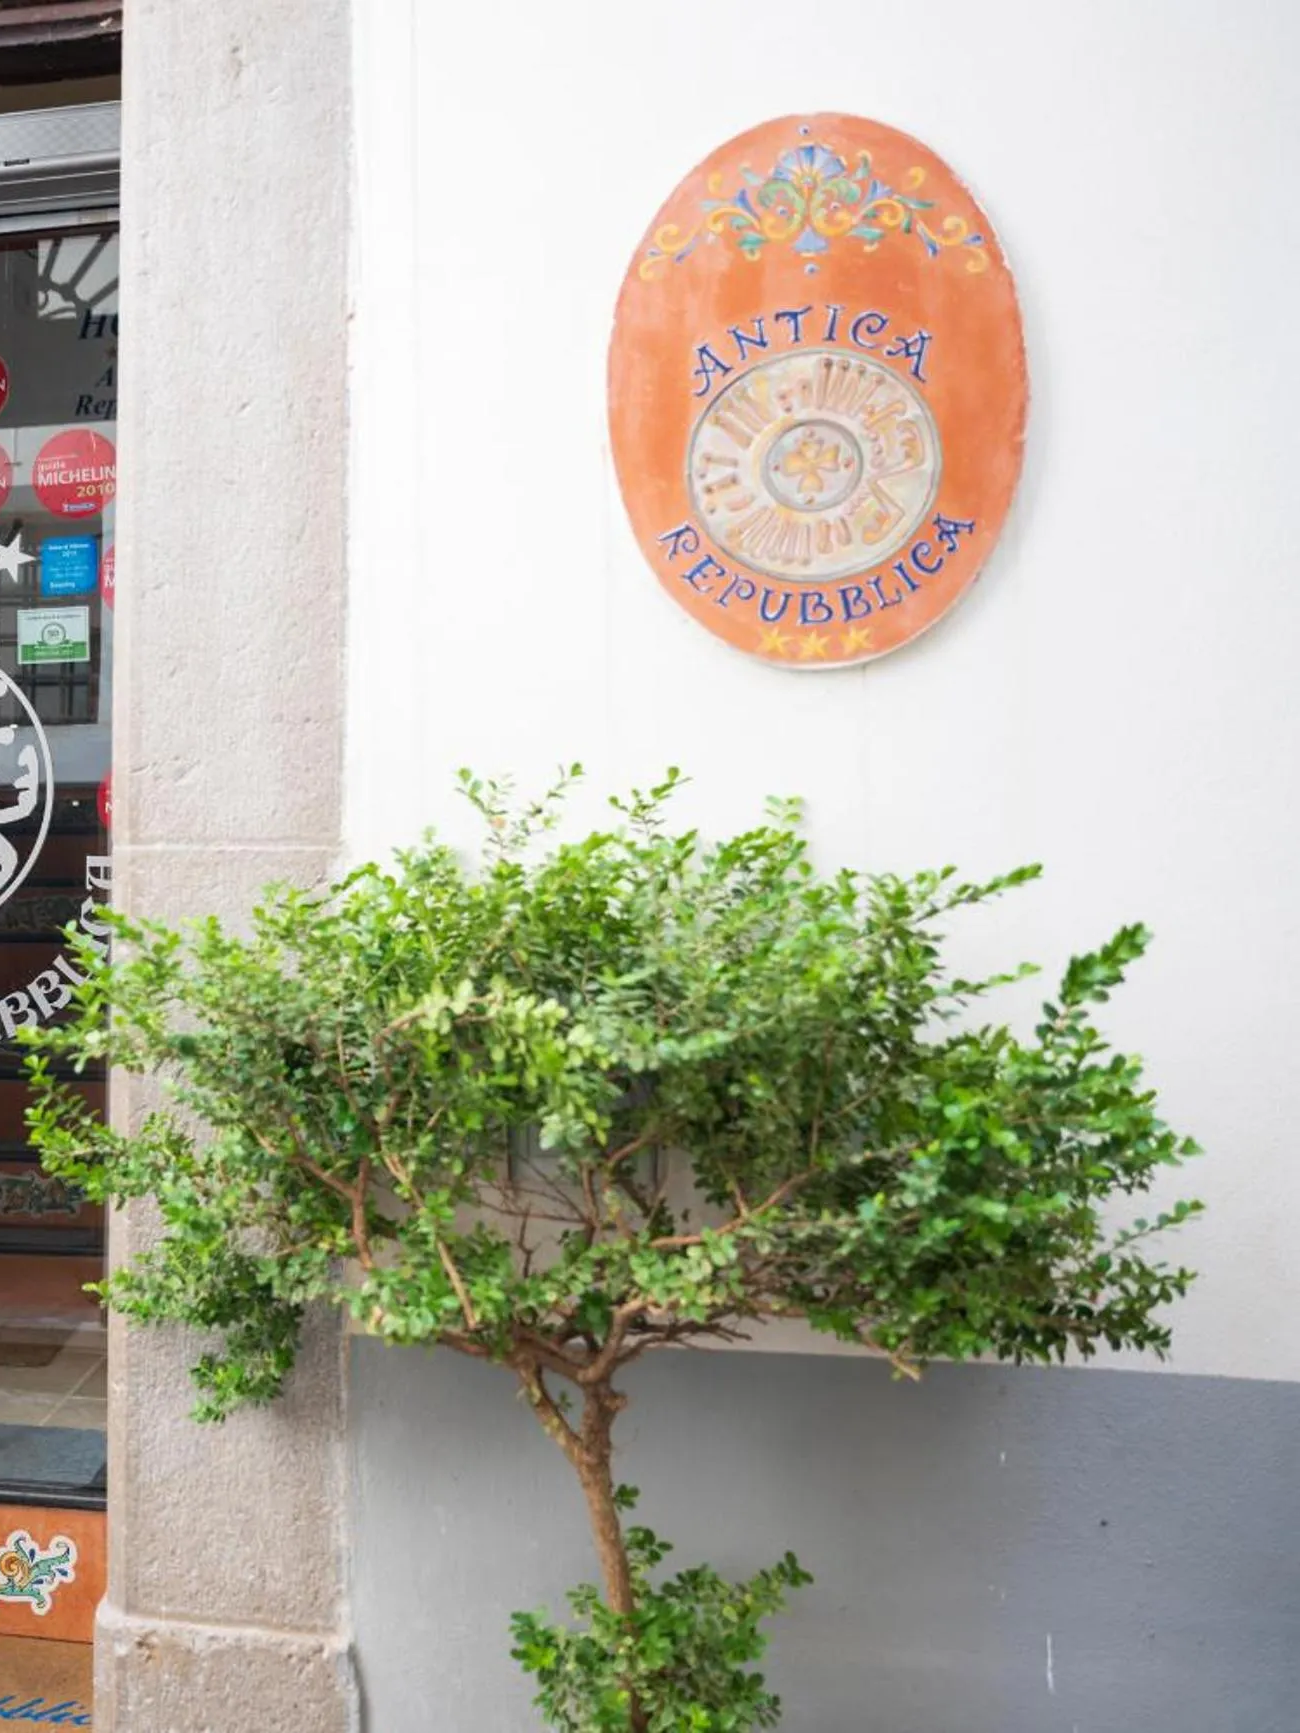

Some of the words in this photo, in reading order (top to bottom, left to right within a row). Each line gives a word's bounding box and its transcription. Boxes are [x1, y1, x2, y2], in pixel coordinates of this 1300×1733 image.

[692, 304, 933, 398] ANTICA
[37, 465, 116, 486] MICHELIN
[657, 512, 976, 625] REPUBBLICA
